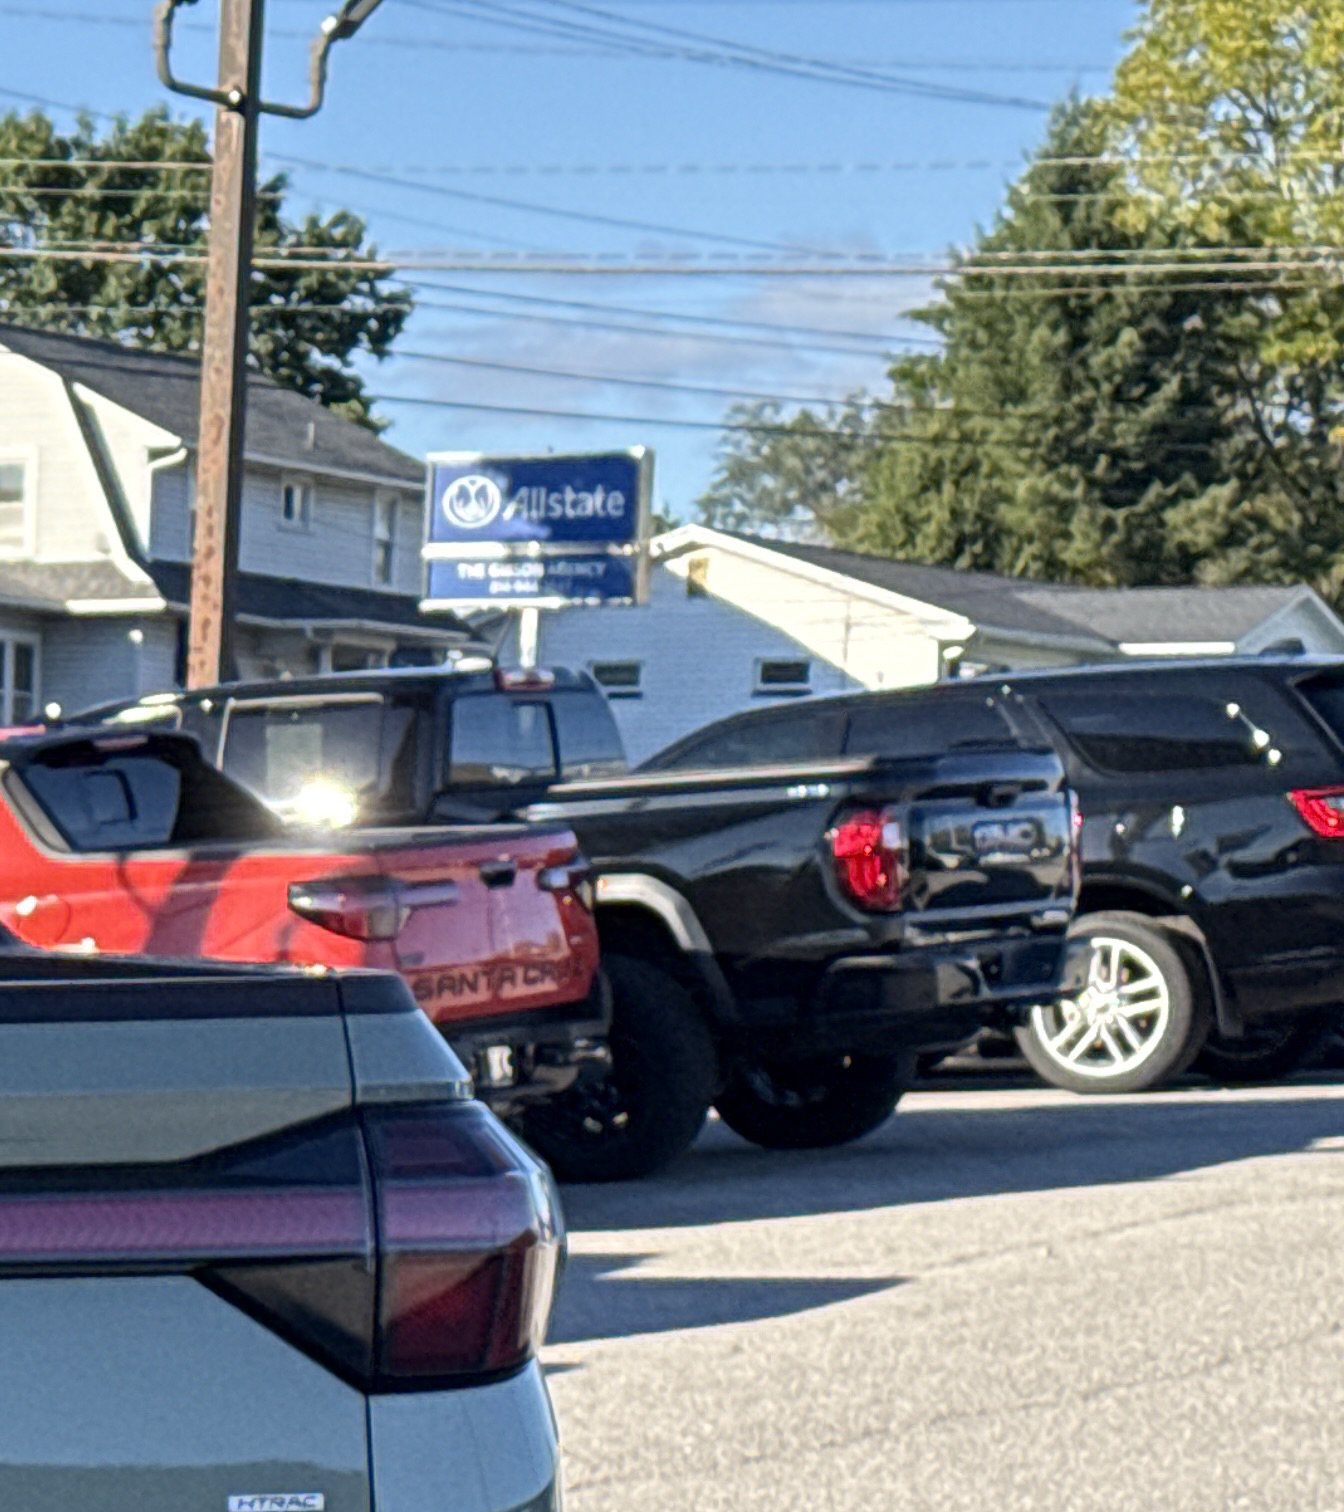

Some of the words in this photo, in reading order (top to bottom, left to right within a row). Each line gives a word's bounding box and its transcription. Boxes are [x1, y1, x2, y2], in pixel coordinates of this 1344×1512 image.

[502, 484, 625, 520] Allstate
[413, 965, 516, 1000] SANTA
[237, 1495, 318, 1511] HTRAC
